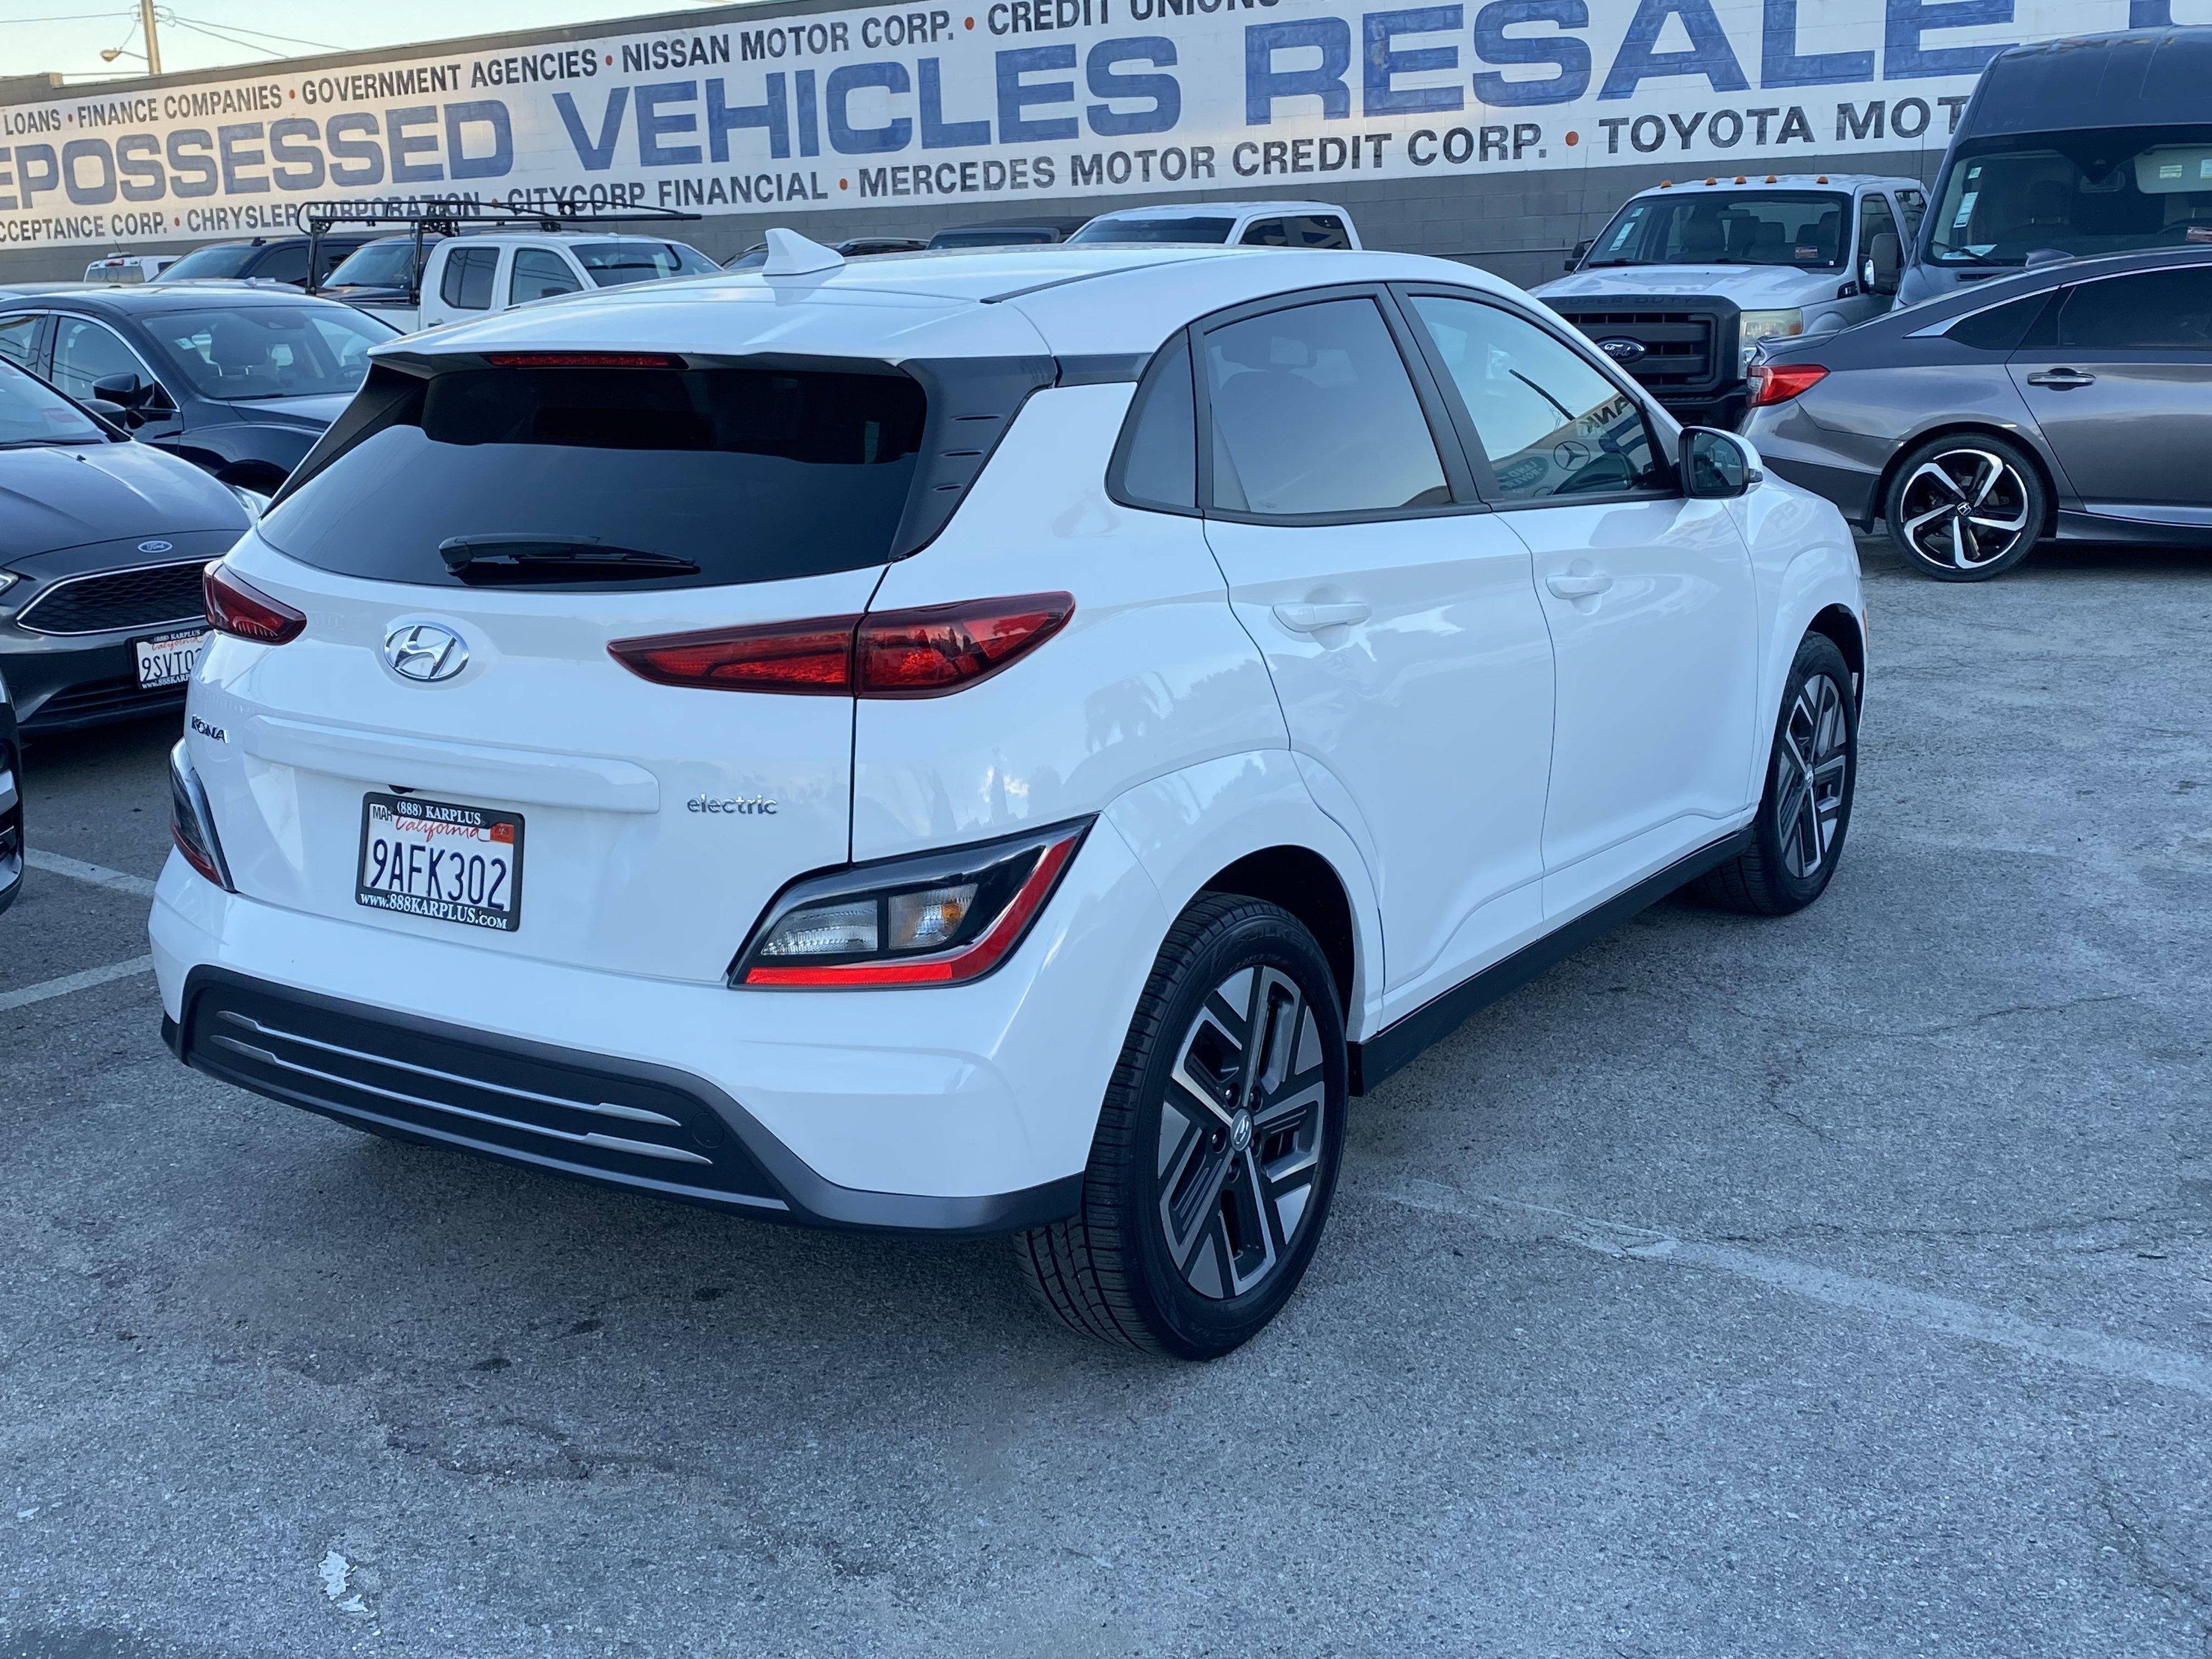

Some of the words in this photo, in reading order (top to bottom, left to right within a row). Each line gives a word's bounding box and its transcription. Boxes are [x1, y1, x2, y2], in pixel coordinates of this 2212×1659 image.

[4, 109, 61, 136] LOANS
[77, 99, 158, 128] FINANCE
[165, 84, 281, 119] COMPANIES
[302, 64, 461, 104] GOVERNMENT
[471, 48, 597, 88] AGENCIES
[622, 34, 729, 73] NISSAN
[741, 21, 849, 61] MOTOR
[861, 10, 954, 48] CORP.
[552, 36, 1182, 171] VEHICLES
[1245, 0, 2020, 126] RESALE
[111, 212, 167, 236] CORP.
[187, 203, 298, 232] CHRYSLER
[658, 172, 828, 207] FINANCIAL
[859, 156, 1056, 198] MERCEDES
[1071, 145, 1215, 187] MOTOR
[1232, 133, 1392, 177] CREDIT
[1408, 123, 1547, 166] CORP.
[1598, 106, 1815, 154] TOYOTA
[1635, 296, 1694, 304] DUTY
[1604, 342, 1631, 357] Ford
[191, 714, 230, 744] KONA
[397, 801, 422, 817] (888)
[425, 805, 481, 825] KARPLUS
[687, 793, 778, 815] electric
[395, 816, 490, 843] California
[370, 838, 507, 911] 9AFK302
